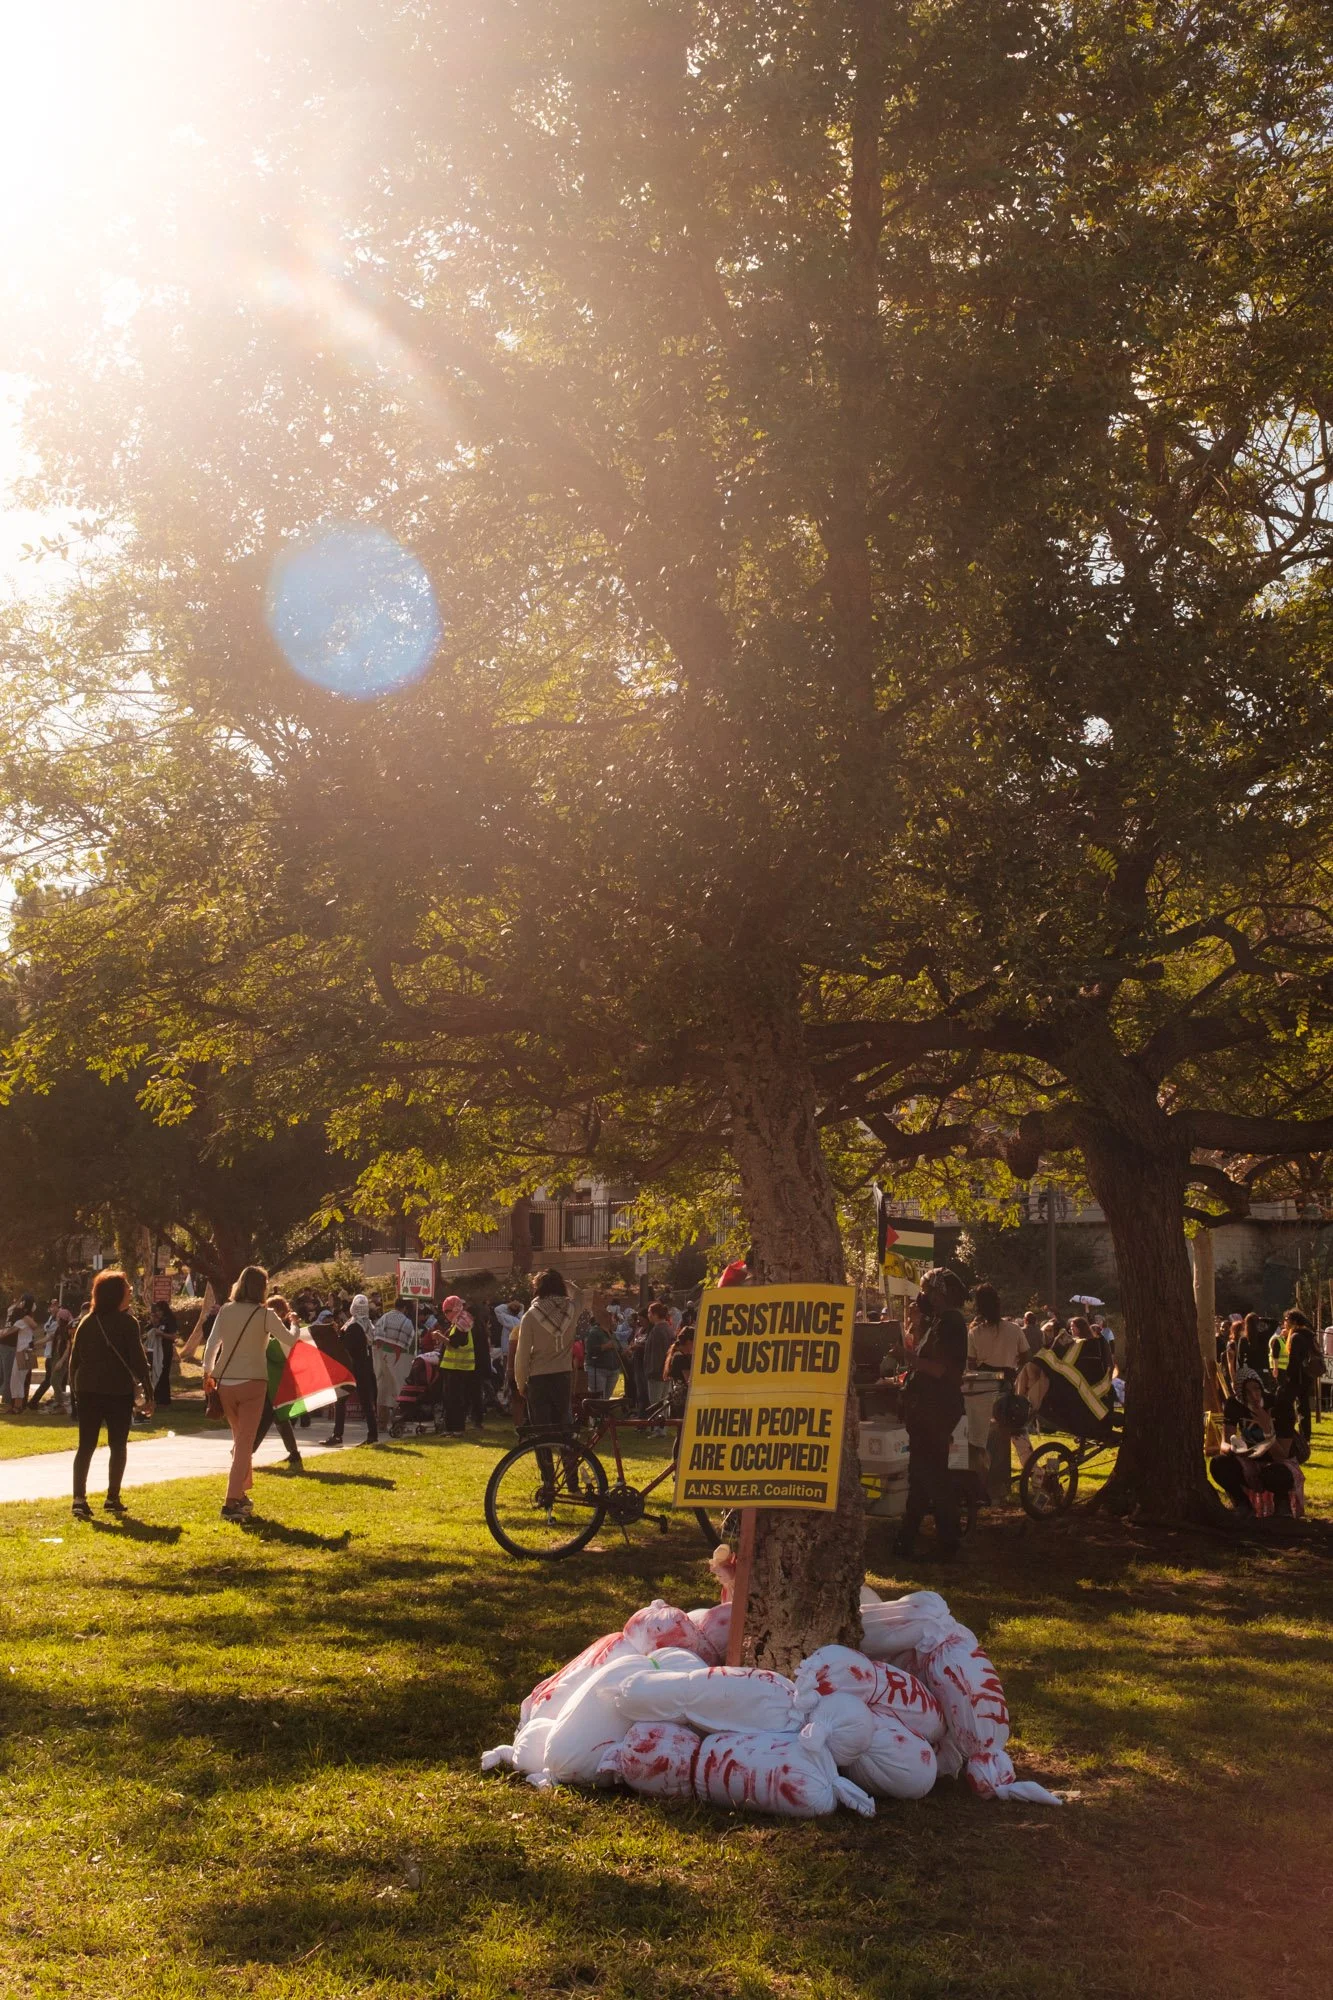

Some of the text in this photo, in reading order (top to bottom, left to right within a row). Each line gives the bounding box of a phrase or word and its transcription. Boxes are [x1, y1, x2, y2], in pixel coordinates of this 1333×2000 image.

[705, 1301, 845, 1336] RESISTANCE
[700, 1340, 841, 1374] IS JUSTIFIED
[695, 1407, 833, 1438] WHEN PEOPLE
[689, 1443, 829, 1473] ARE OCCUPIED!
[688, 1483, 823, 1498] A.N.S.W.E.R. Coalition
